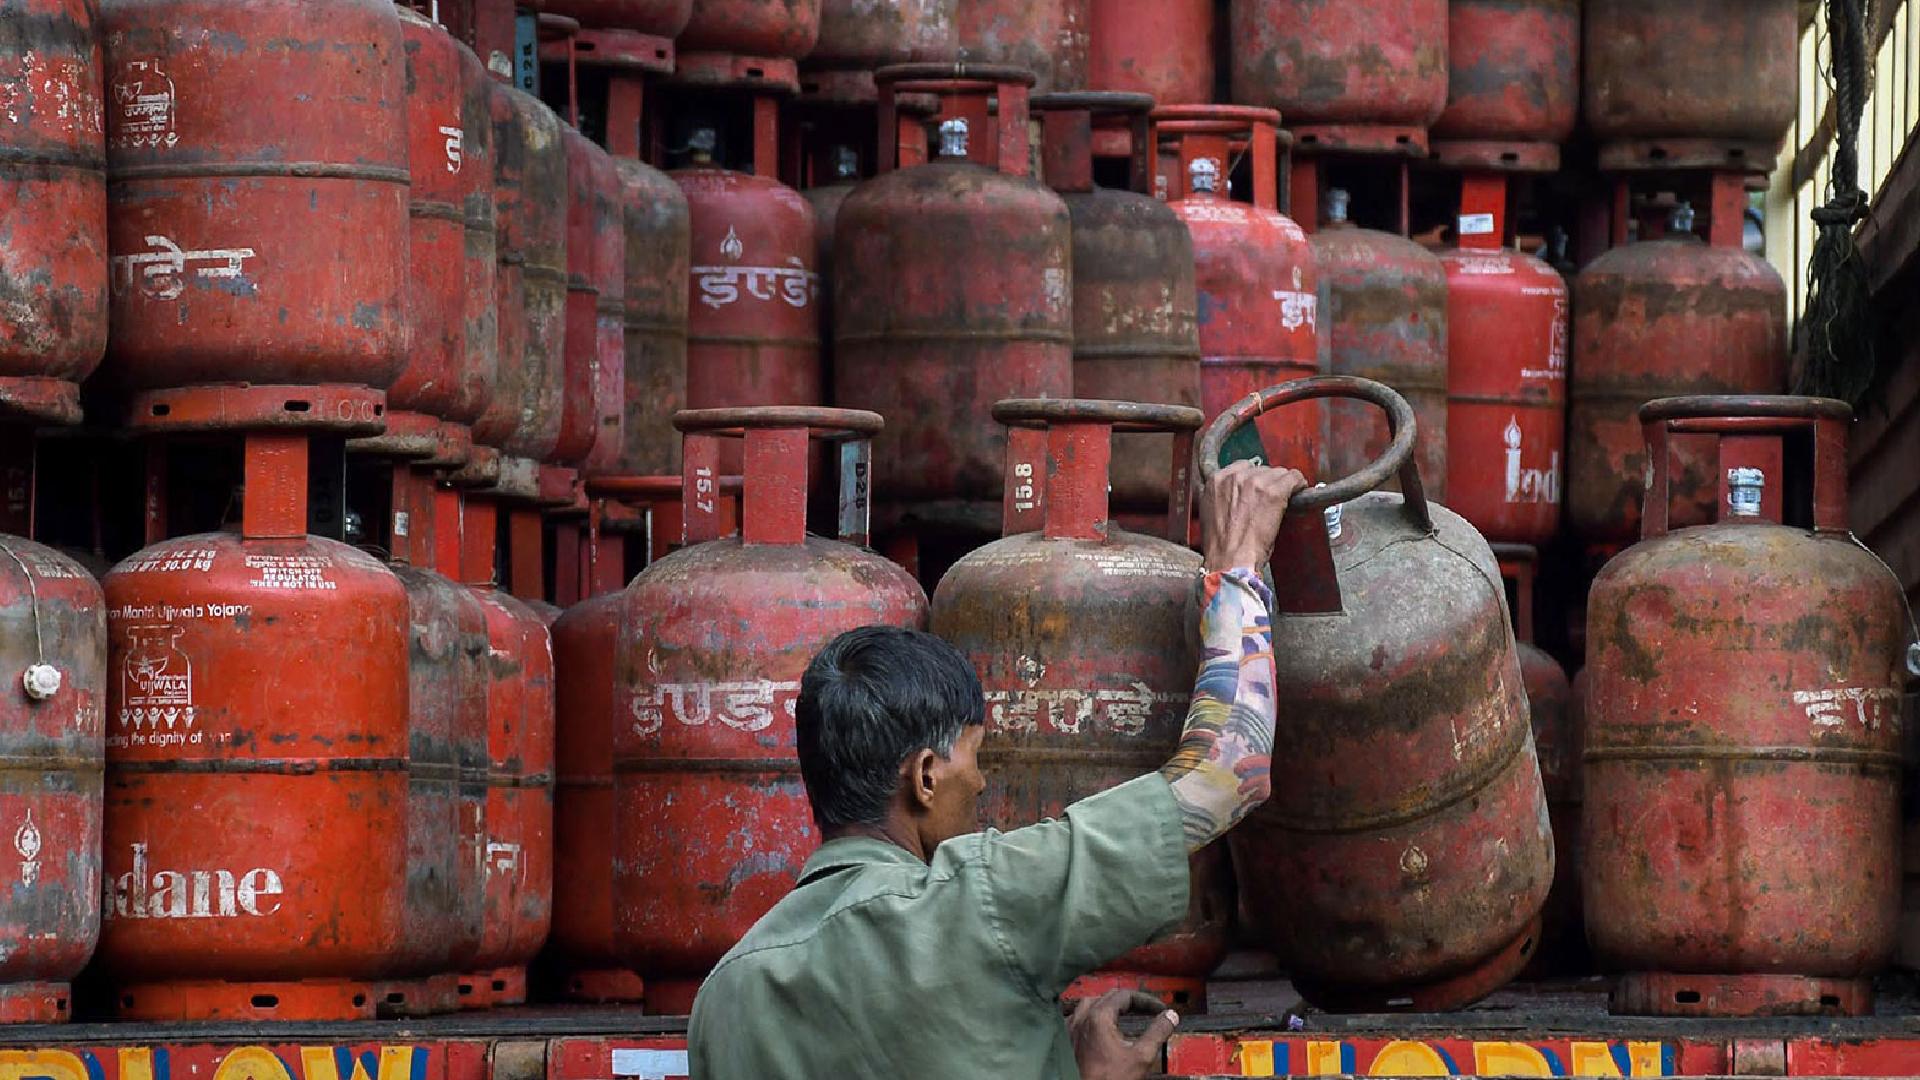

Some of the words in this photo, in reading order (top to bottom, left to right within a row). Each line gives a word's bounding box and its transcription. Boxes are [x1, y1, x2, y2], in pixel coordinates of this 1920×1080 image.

[696, 466, 713, 514] 15.7
[1015, 463, 1033, 513] 15.8
[1504, 447, 1560, 503] Ind
[149, 731, 187, 748] dignity
[190, 730, 203, 744] of
[103, 843, 284, 918] dane
